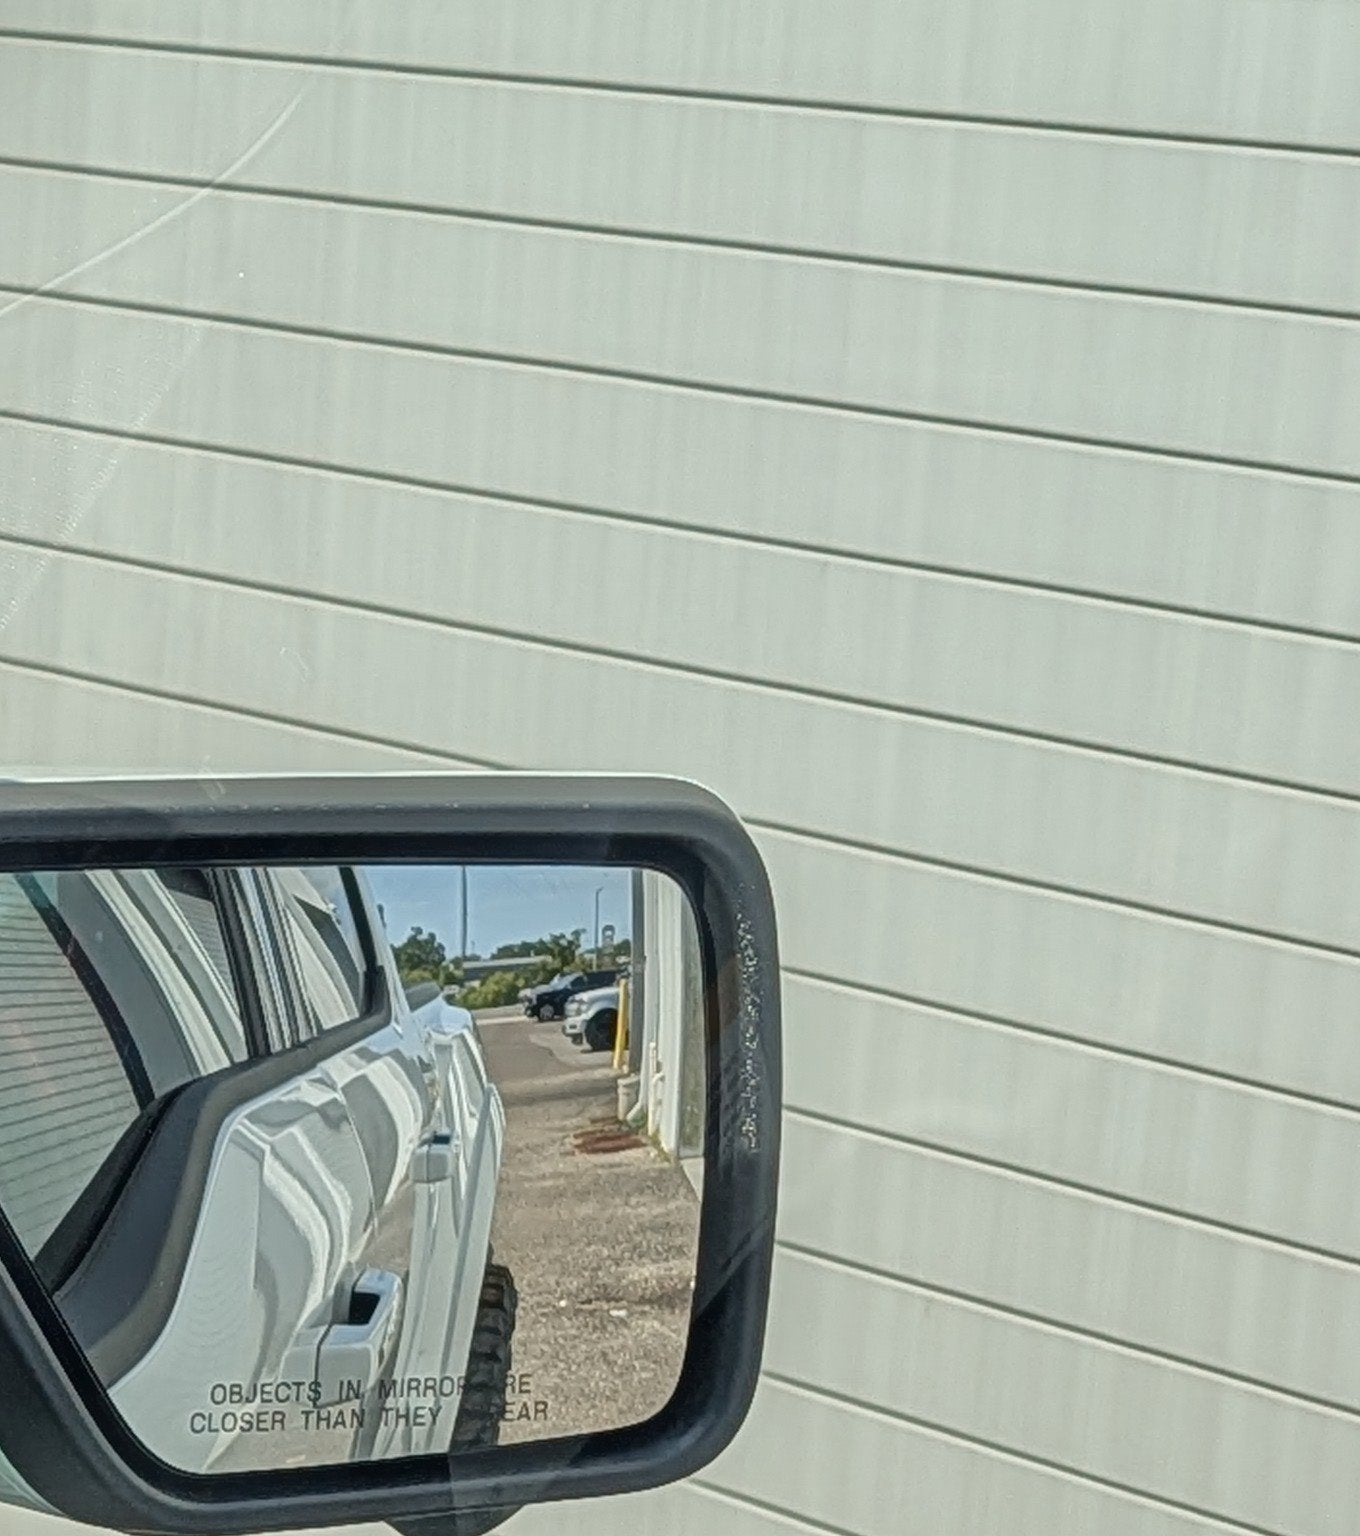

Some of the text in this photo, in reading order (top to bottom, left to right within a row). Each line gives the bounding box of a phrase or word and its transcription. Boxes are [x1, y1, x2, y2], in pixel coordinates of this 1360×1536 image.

[210, 1381, 322, 1405] OBJECTS
[339, 1379, 361, 1400] IN
[506, 1373, 532, 1395] RE
[190, 1410, 286, 1434] CLOSER
[301, 1408, 365, 1431] THAN
[381, 1406, 442, 1427] THEY
